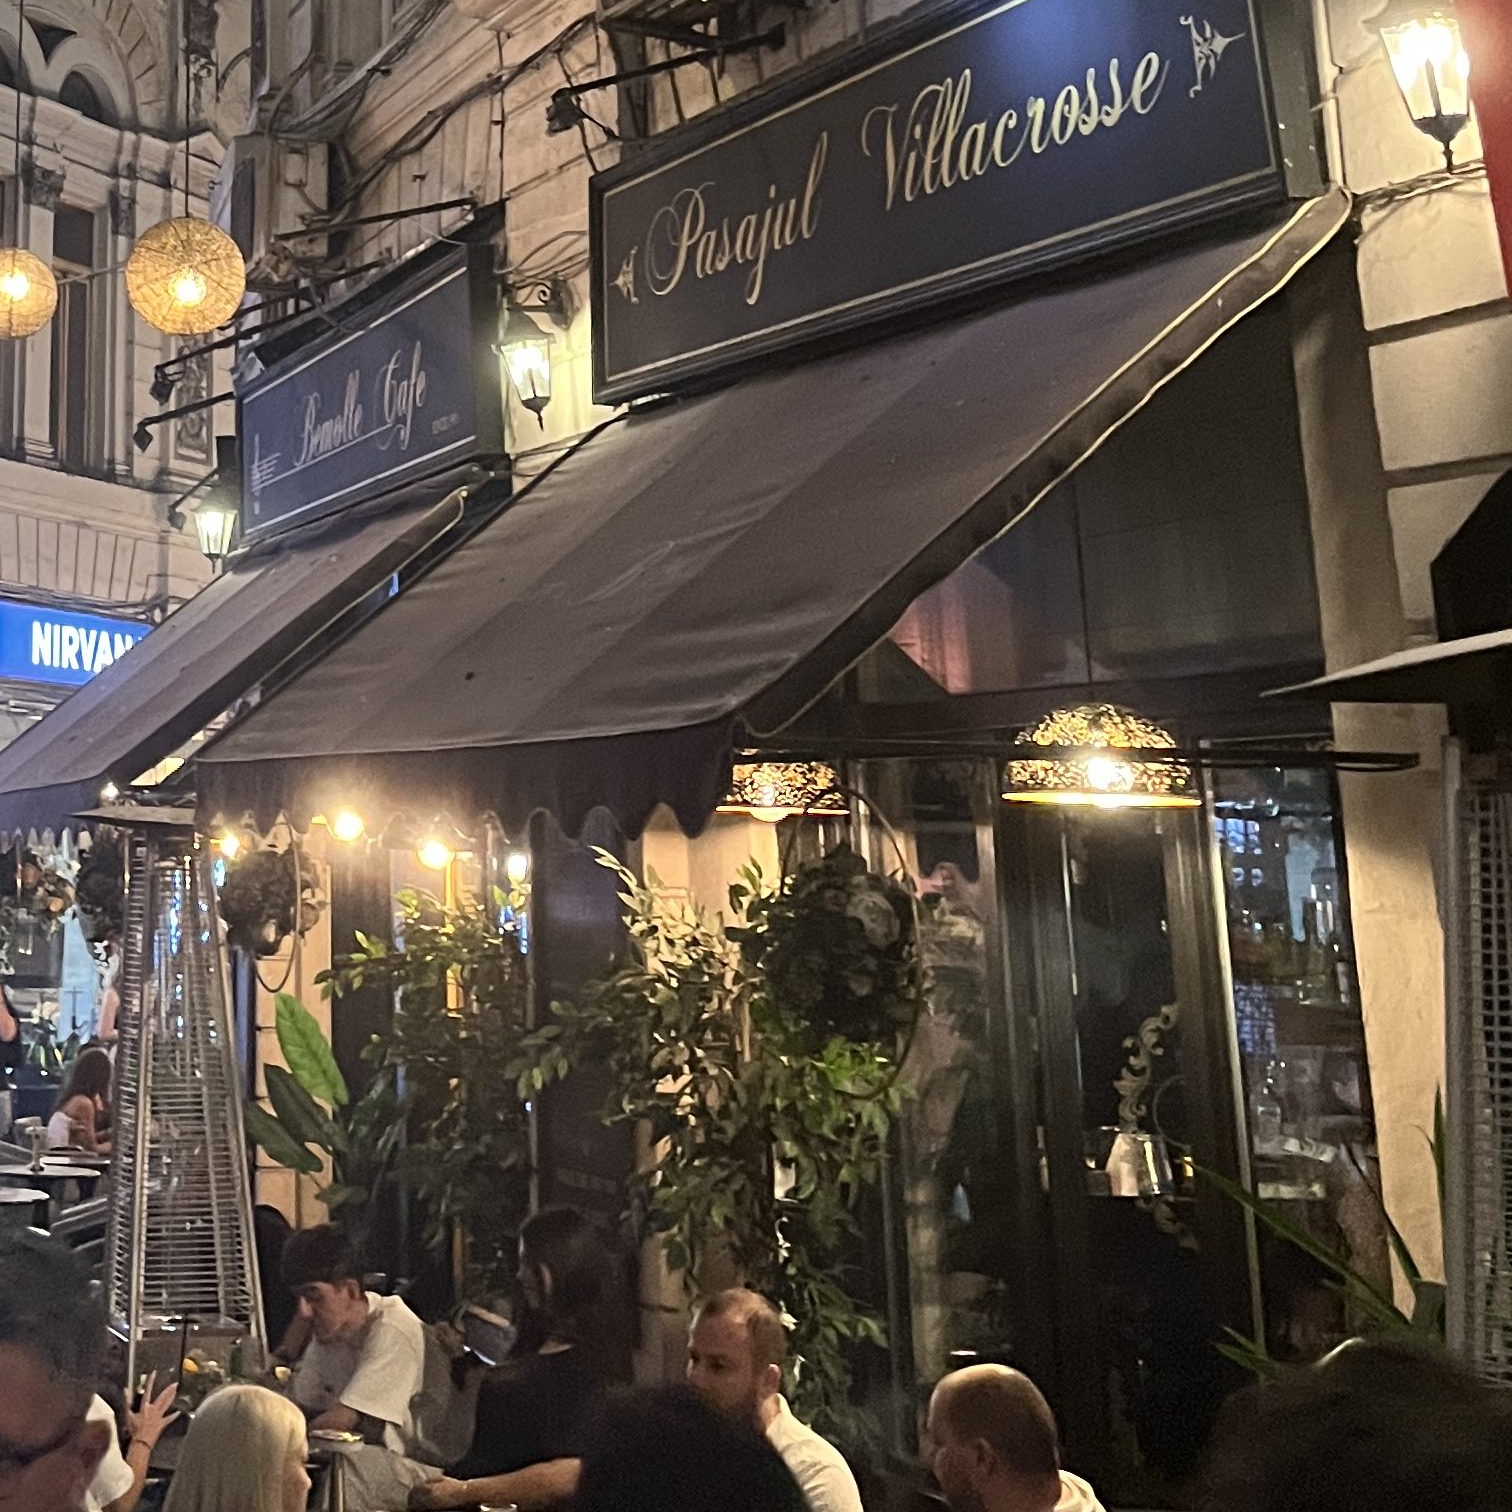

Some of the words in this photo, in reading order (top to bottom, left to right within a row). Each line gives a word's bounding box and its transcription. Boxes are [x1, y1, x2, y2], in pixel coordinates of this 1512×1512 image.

[645, 130, 828, 306] Pasajul
[861, 50, 1170, 211] Villacrosse
[31, 620, 143, 674] NIRVAN
